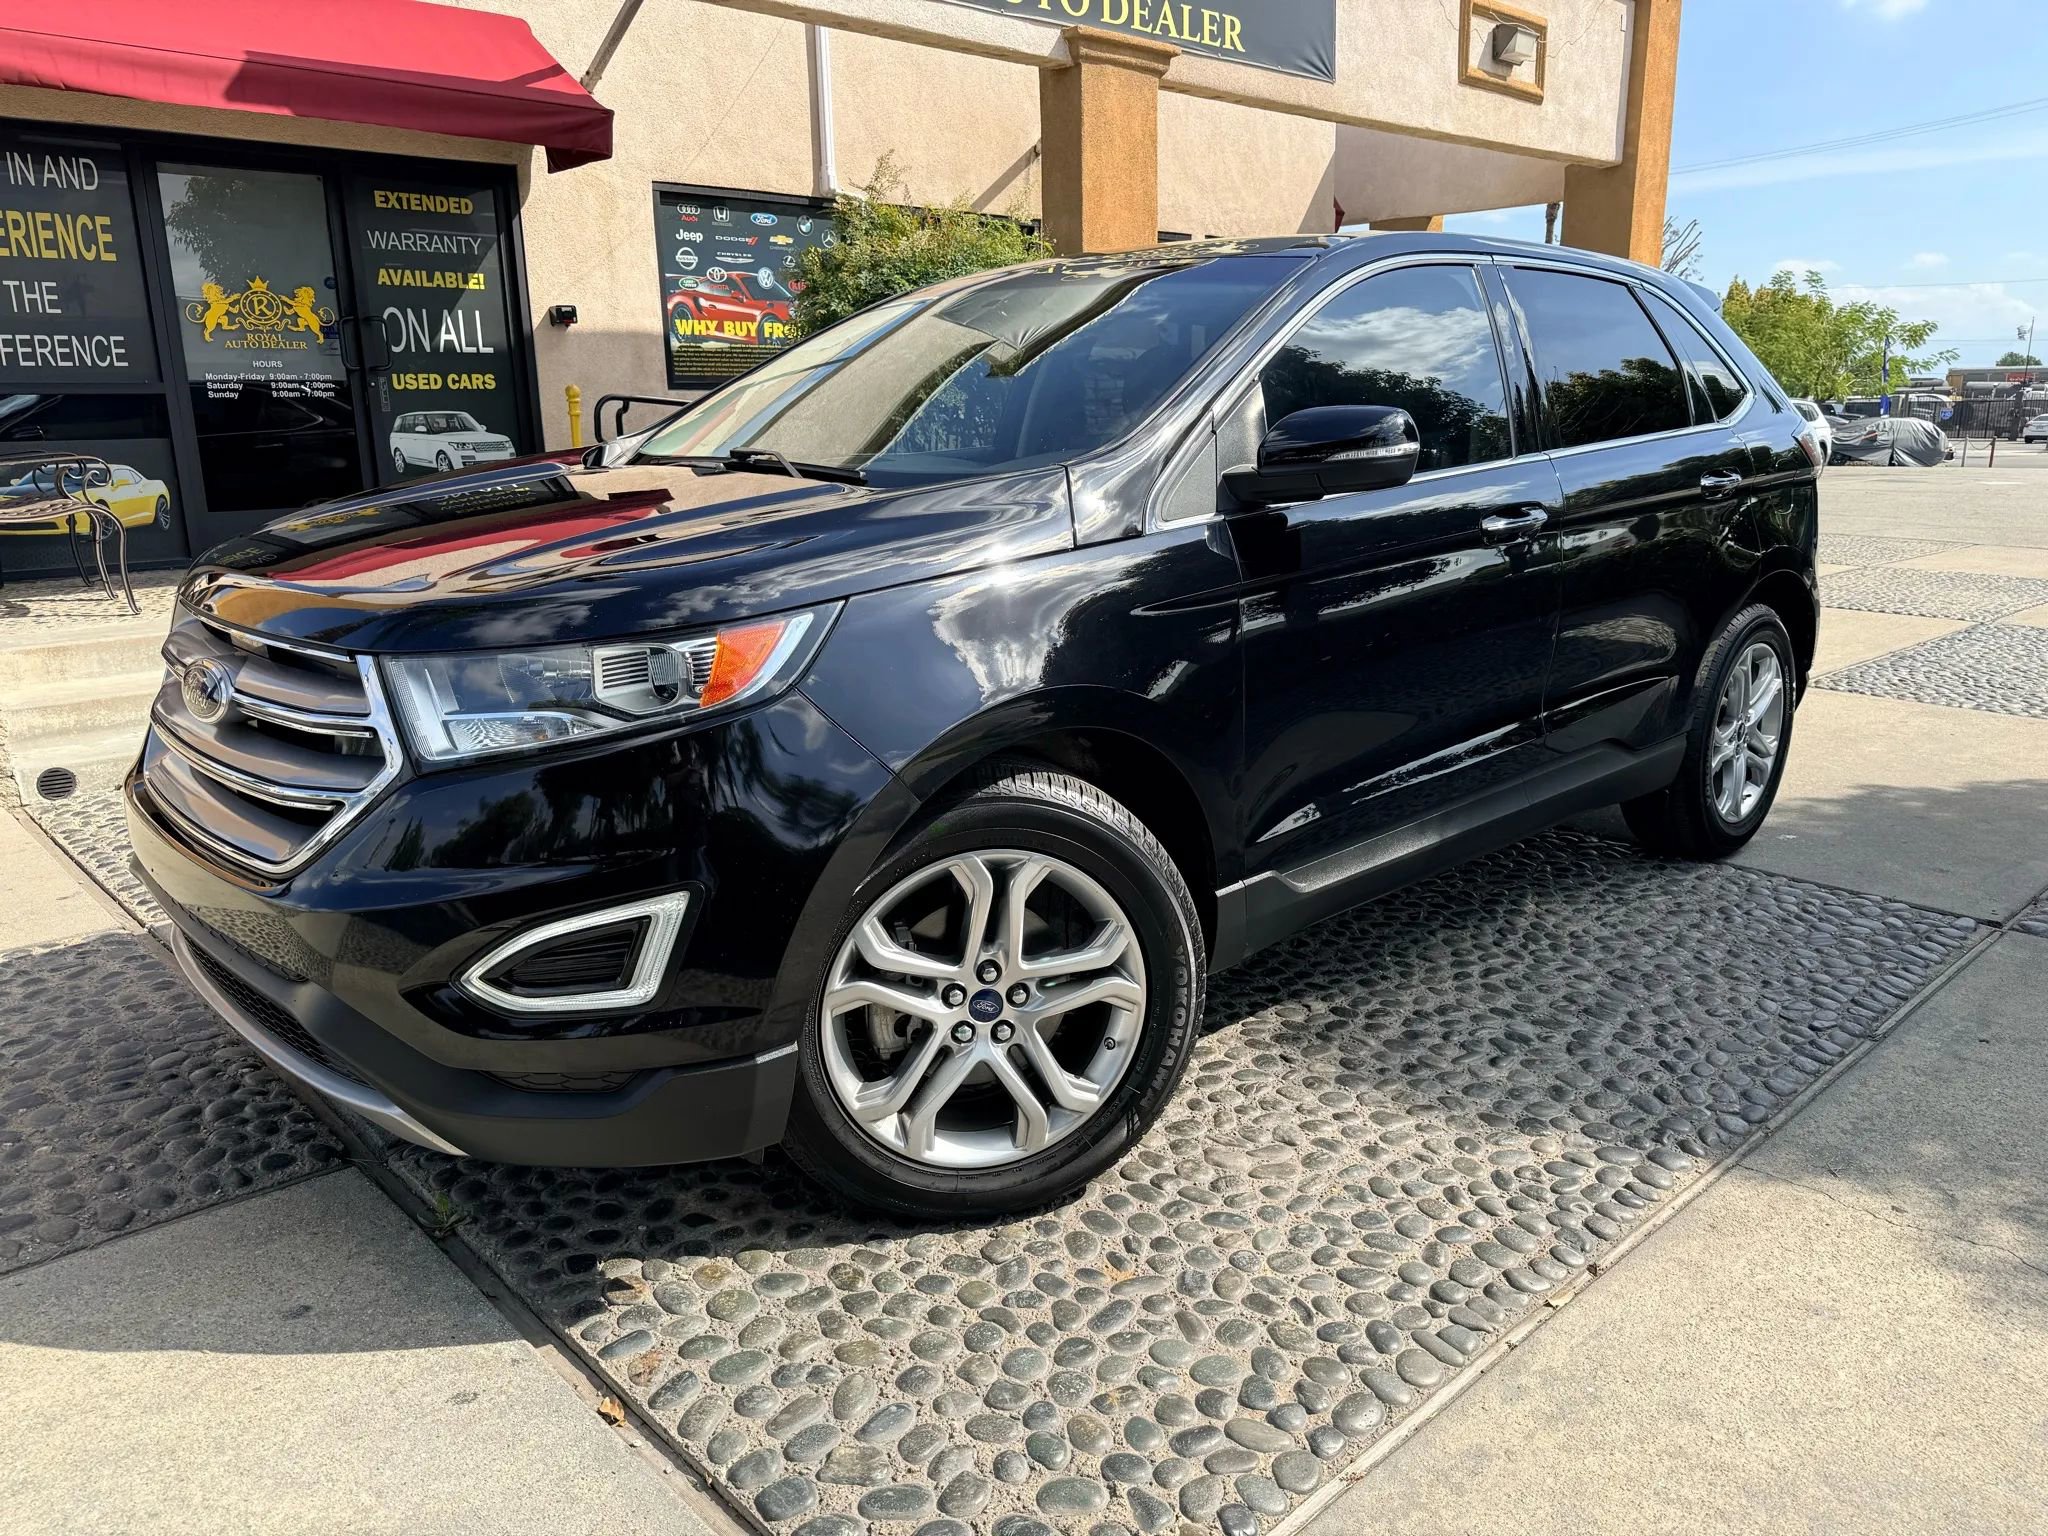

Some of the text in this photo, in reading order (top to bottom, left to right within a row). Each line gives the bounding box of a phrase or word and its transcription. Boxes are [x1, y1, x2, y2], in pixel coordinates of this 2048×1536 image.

[1100, 0, 1246, 53] DEALER
[6, 152, 98, 191] IN AND
[373, 190, 474, 215] EXTENDED
[367, 230, 482, 255] WARRANTY
[675, 229, 703, 243] Jeep
[377, 268, 485, 290] AVAILABLE!
[3, 280, 62, 314] THE
[382, 306, 494, 353] ON ALL
[674, 319, 718, 336] WHY
[723, 320, 757, 337] BUY
[225, 340, 308, 350] AUTO DEALER
[247, 333, 286, 342] ROYAL
[252, 360, 283, 368] HOURS
[205, 373, 265, 381] Monday-Friday
[304, 373, 332, 382] 7:00pm
[206, 382, 243, 390] Saturday
[391, 373, 497, 390] USED CARS
[208, 391, 239, 399] Sunday
[307, 391, 335, 399] 7:00pm
[1139, 944, 1189, 1107] YOKOHAMA
